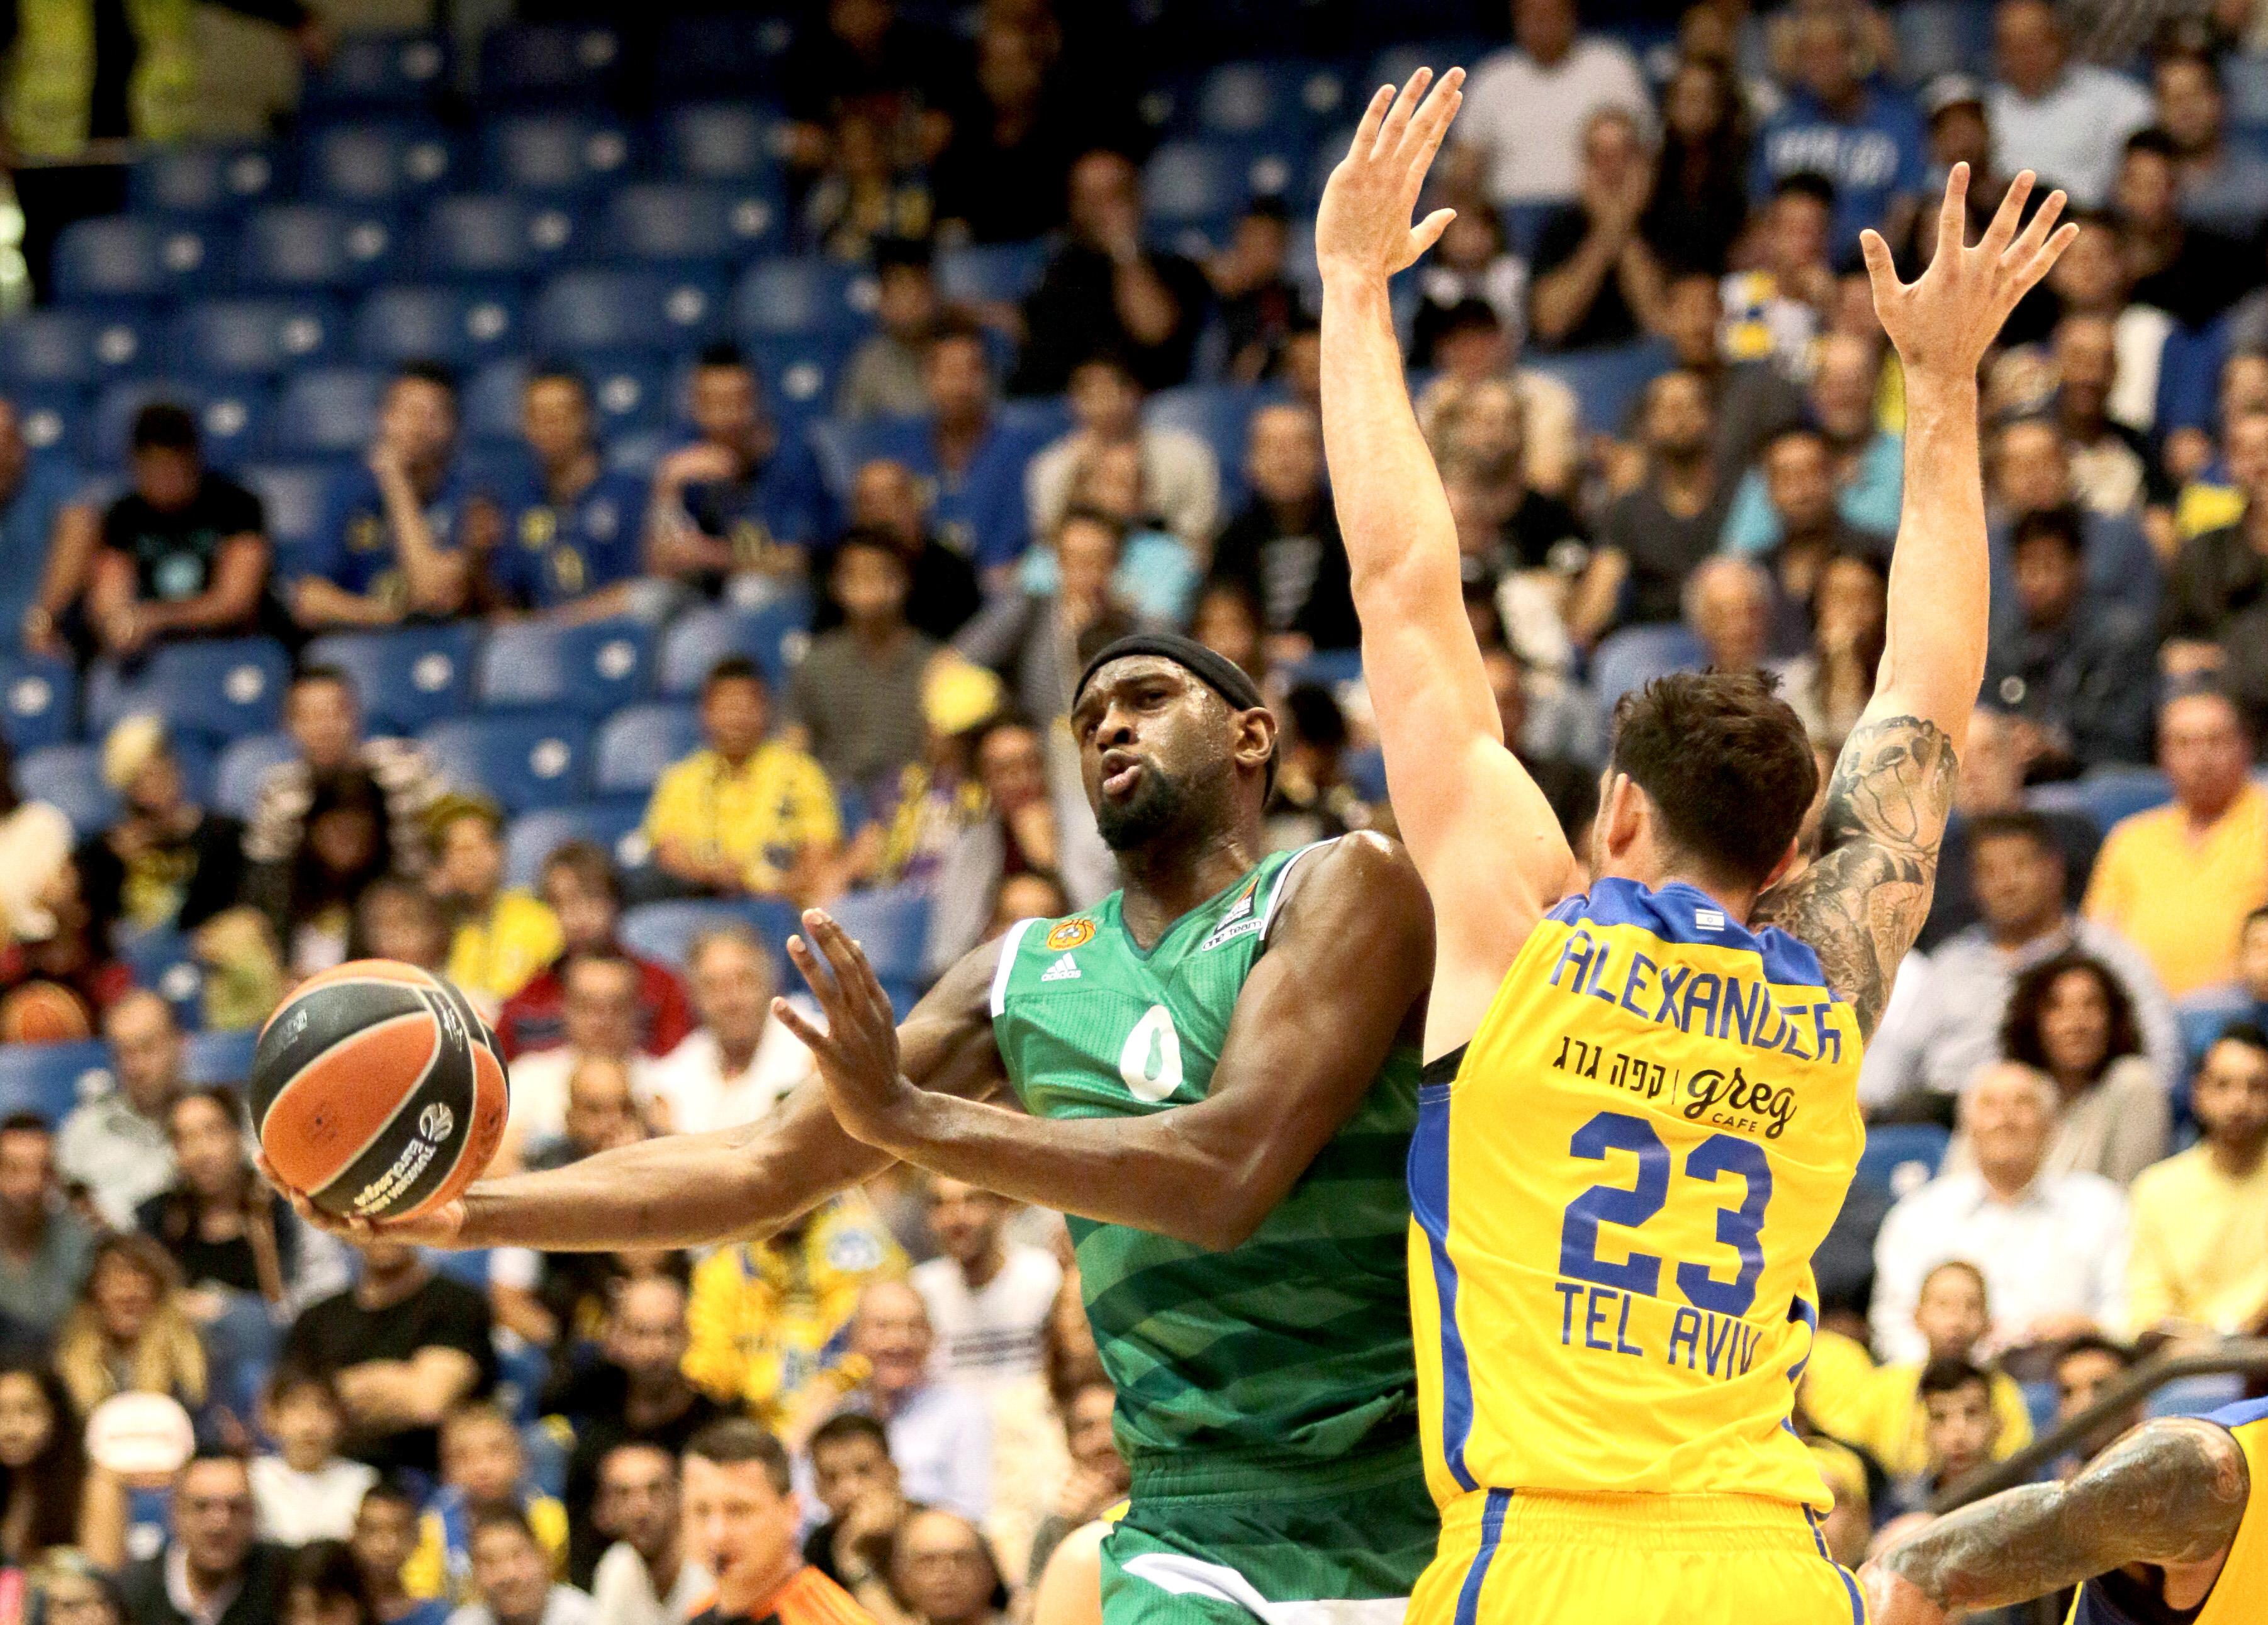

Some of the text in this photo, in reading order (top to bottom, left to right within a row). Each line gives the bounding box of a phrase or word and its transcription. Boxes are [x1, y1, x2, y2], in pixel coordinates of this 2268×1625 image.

[1203, 921, 1262, 949] one team
[1041, 969, 1082, 981] adidas
[1549, 930, 1841, 1064] ALEXANDER
[1120, 1005, 1182, 1102] 0
[1552, 1036, 1666, 1099] קפה גרג
[1684, 1067, 1797, 1139] greg
[1712, 1112, 1758, 1132] CAFE
[1559, 1111, 1773, 1317] 23
[1555, 1282, 1762, 1380] TEL AVIV
